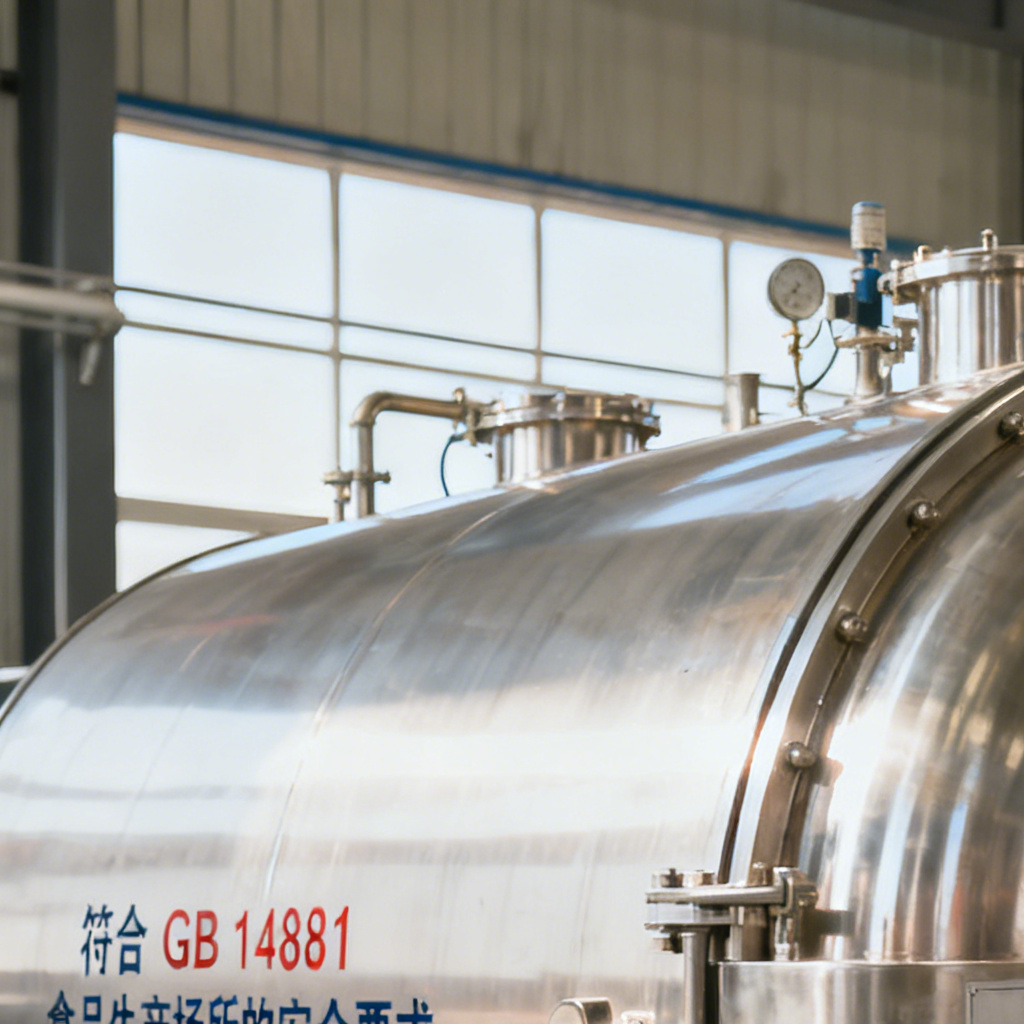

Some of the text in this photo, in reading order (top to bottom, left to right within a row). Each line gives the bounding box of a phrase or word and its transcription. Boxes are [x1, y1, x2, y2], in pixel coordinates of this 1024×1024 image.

[80, 903, 350, 977] 符合 GB 14881
